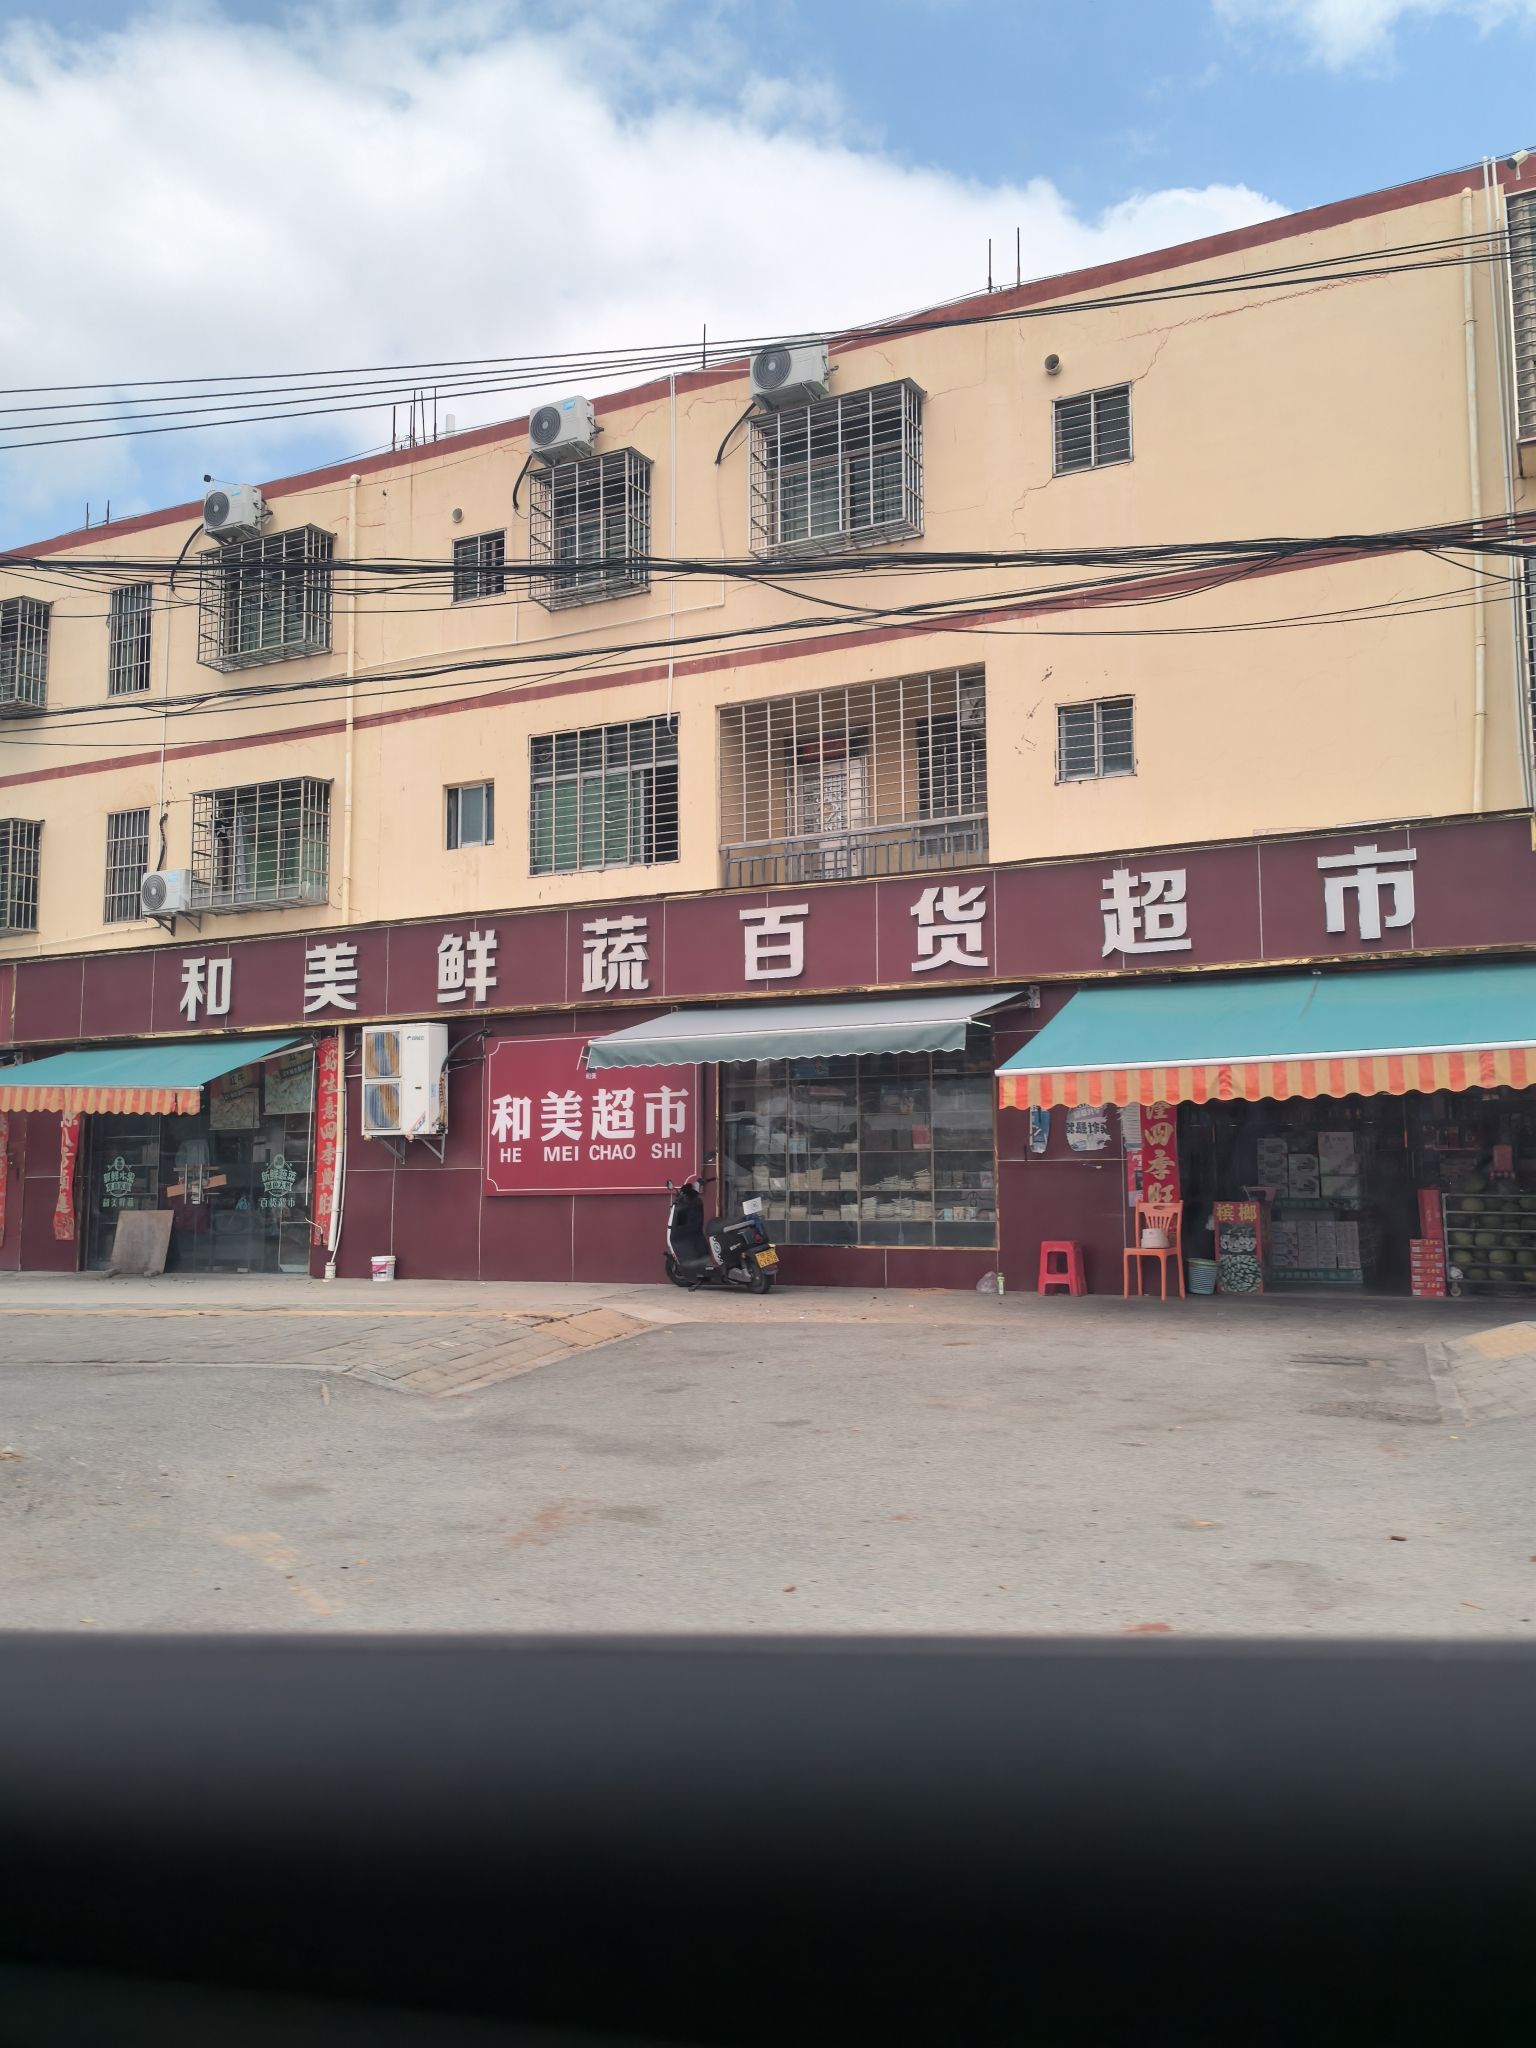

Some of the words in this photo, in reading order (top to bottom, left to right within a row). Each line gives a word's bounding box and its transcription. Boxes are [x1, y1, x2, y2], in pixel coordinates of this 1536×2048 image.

[179, 845, 1417, 1021] 和美鲜蔬百货超市
[491, 1085, 689, 1143] 和美超市
[500, 1147, 521, 1163] HE
[543, 1145, 579, 1162] MEI
[589, 1143, 636, 1161] CHAO
[651, 1142, 682, 1159] SHI
[1216, 1203, 1258, 1223] 槟榔
